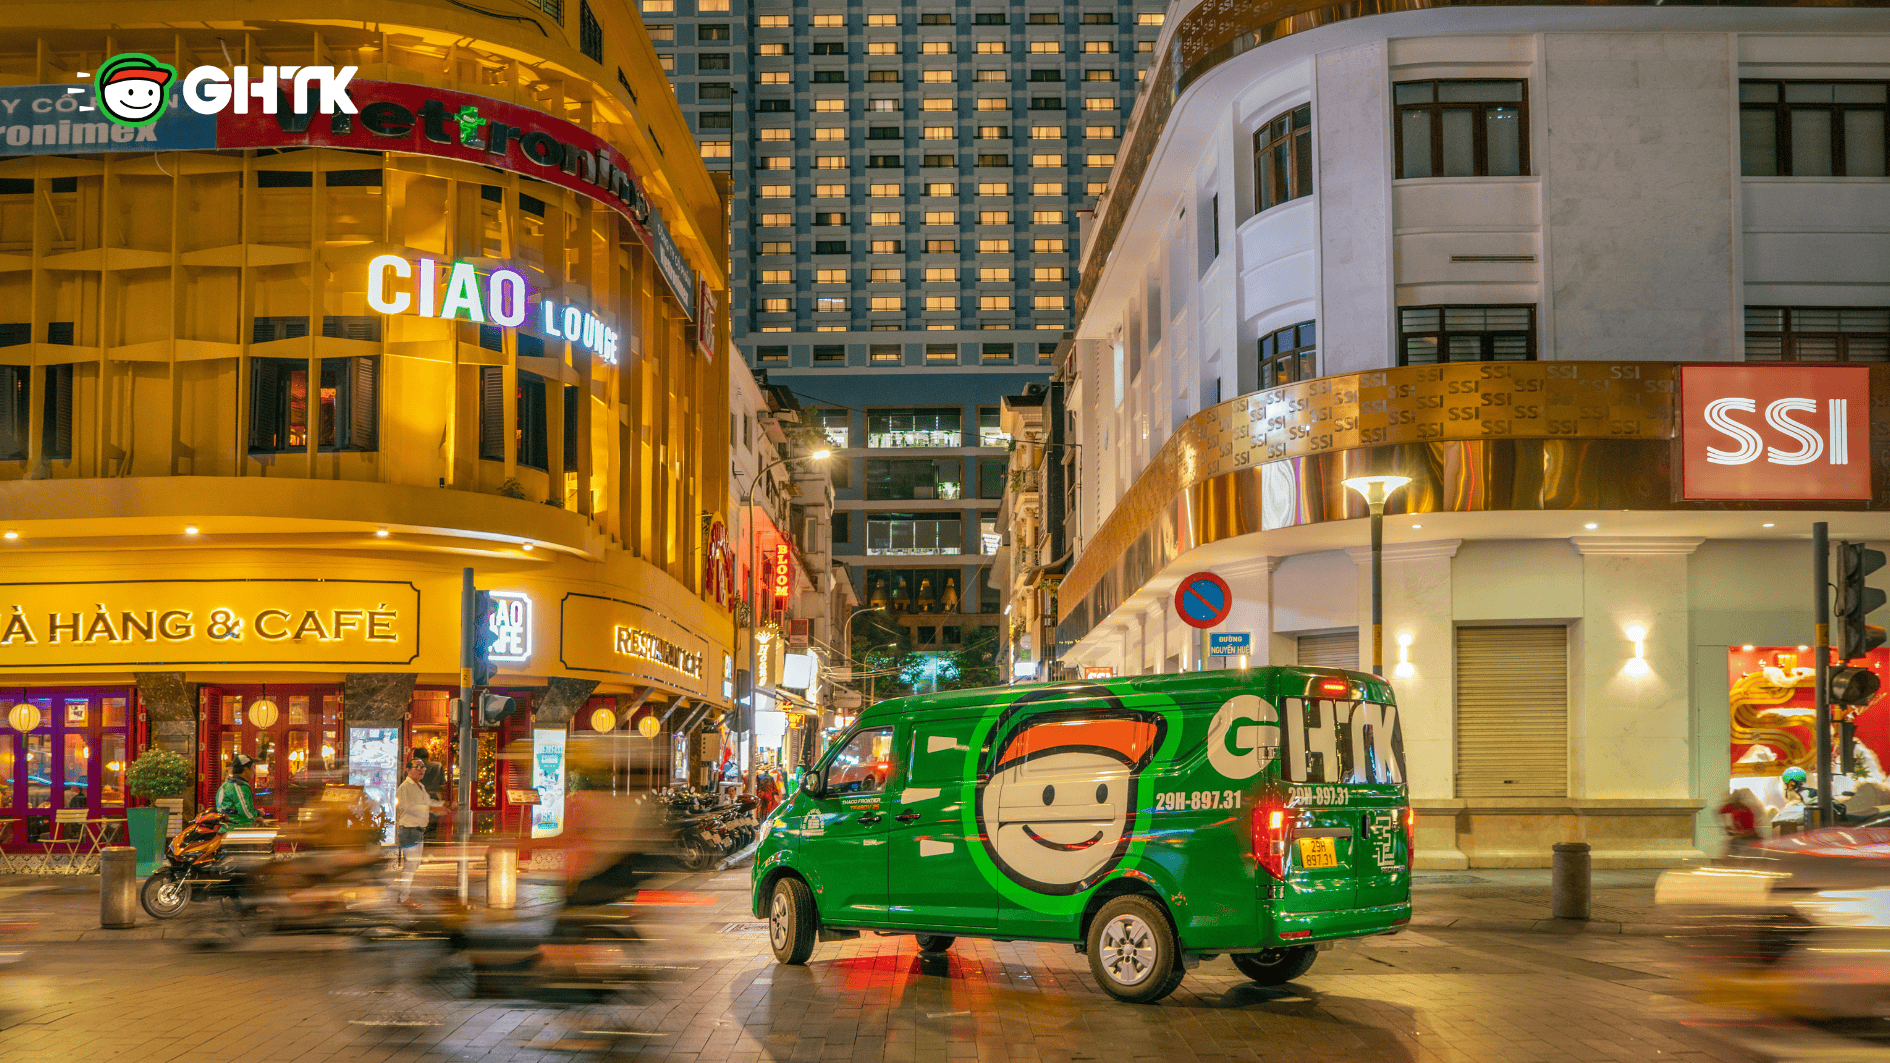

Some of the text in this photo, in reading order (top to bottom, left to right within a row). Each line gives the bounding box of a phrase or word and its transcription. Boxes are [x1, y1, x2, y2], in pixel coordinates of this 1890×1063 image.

[367, 255, 525, 327] CIAO
[545, 301, 618, 365] LOUNGE
[1704, 398, 1848, 465] SSI
[775, 544, 788, 597] BLOOM
[49, 603, 194, 643] HÀNG
[207, 607, 243, 641] &
[254, 603, 397, 641] CAFÉ
[1208, 695, 1403, 784] GHTK
[1156, 790, 1241, 811] 29H-897.31
[1306, 853, 1333, 867] 897.31
[1311, 840, 1326, 852] 29H
